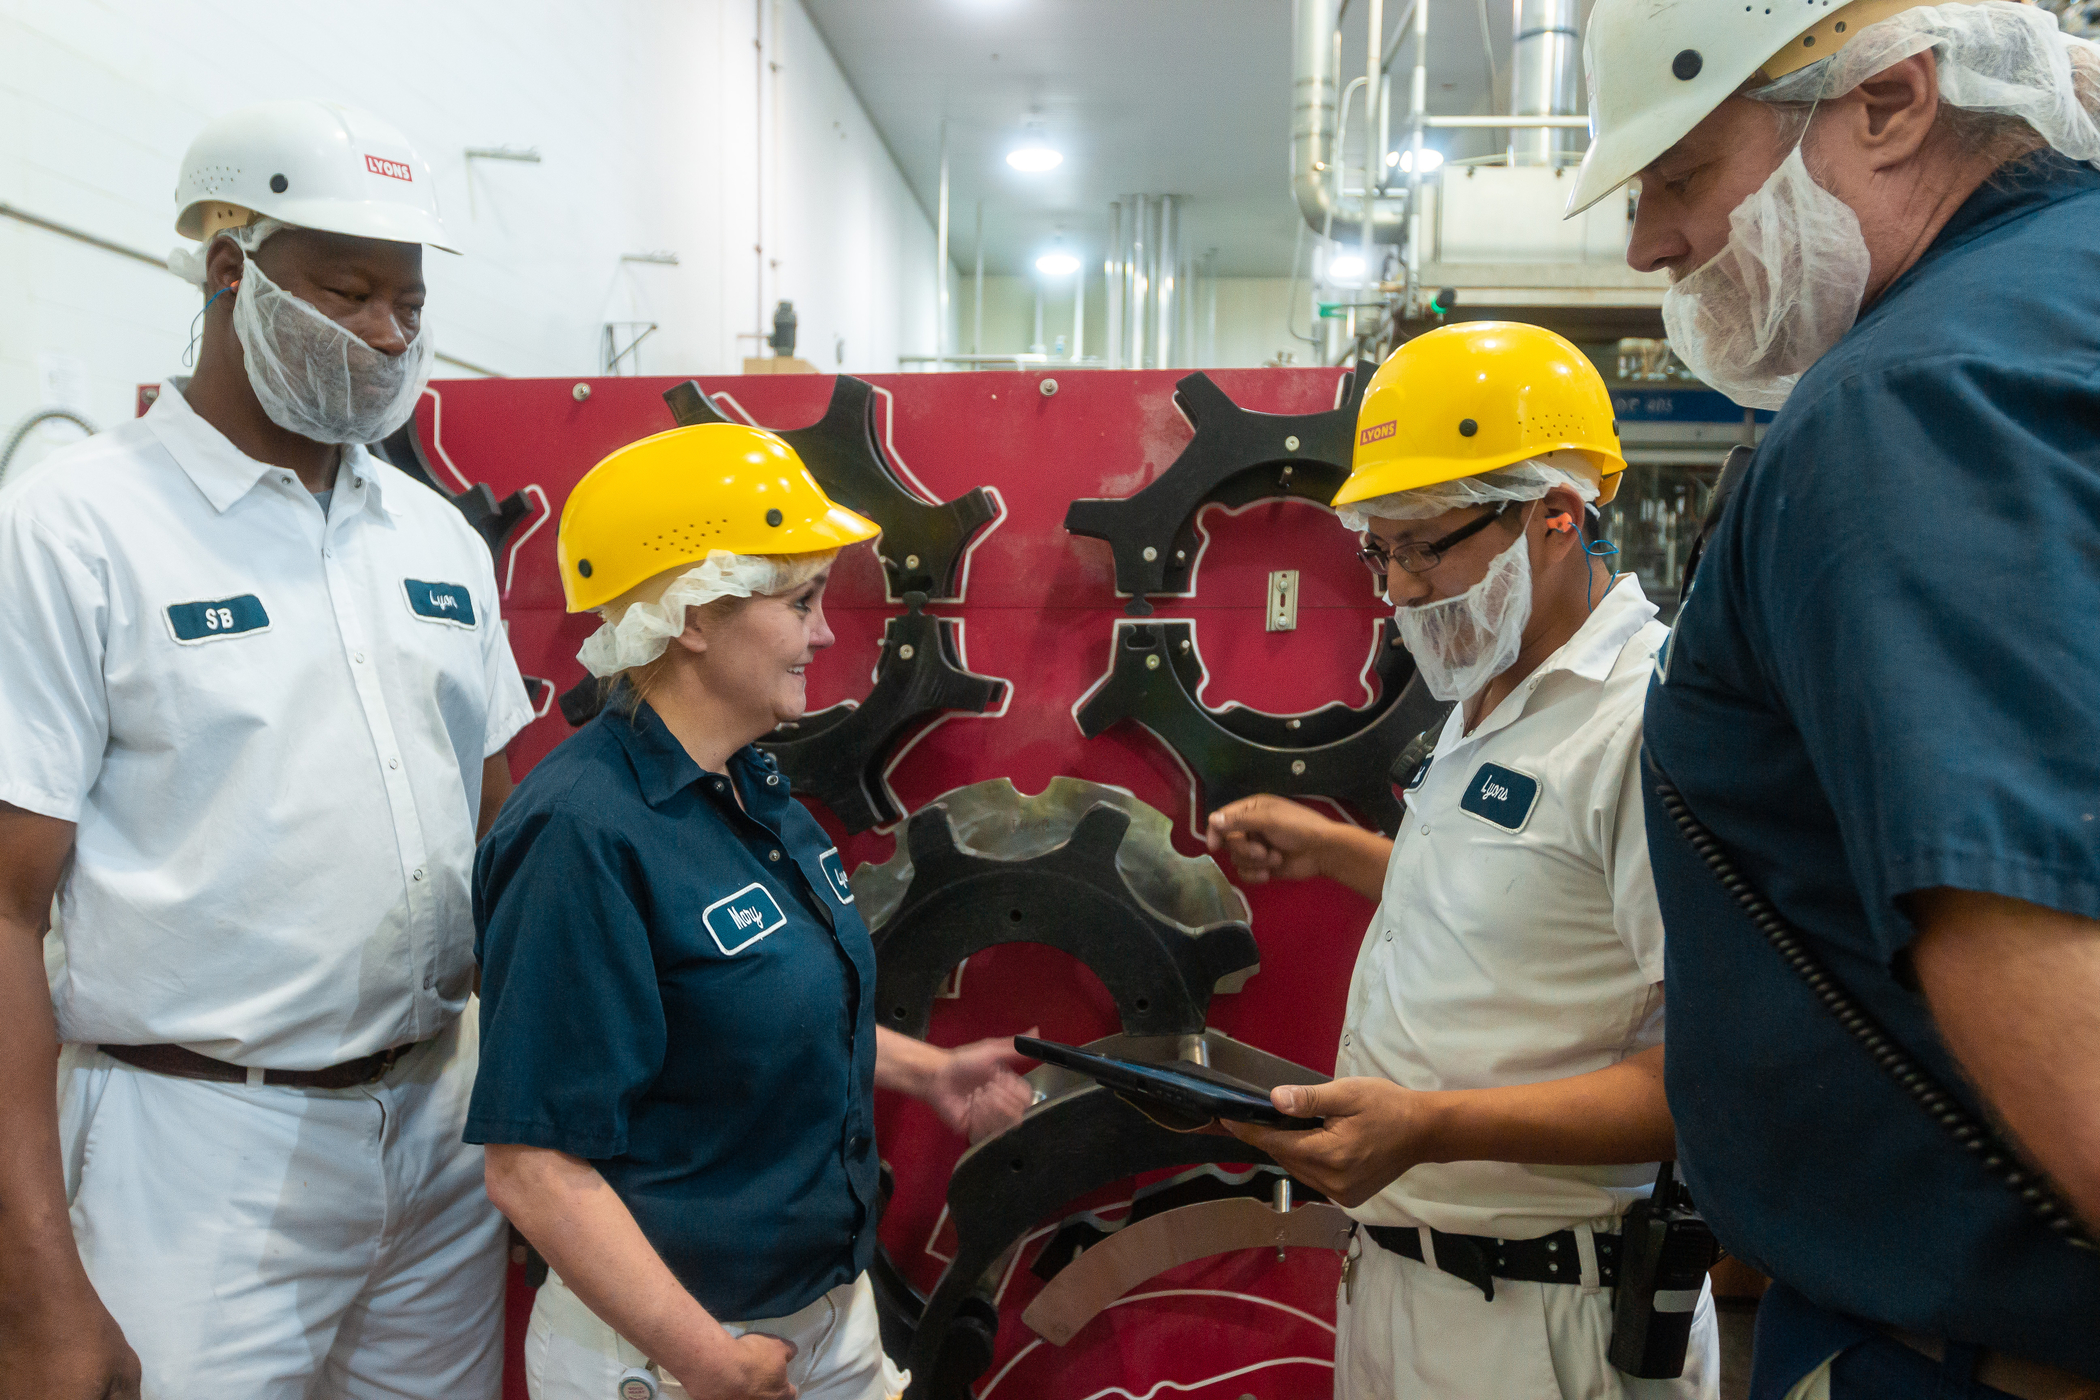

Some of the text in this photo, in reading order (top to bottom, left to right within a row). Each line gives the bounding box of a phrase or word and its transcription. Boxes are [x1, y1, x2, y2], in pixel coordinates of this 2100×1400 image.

[367, 156, 410, 180] LYONS
[1362, 422, 1395, 443] LYONS
[205, 607, 235, 630] SB
[1480, 774, 1509, 801] Lyons
[726, 905, 764, 930] Mary
